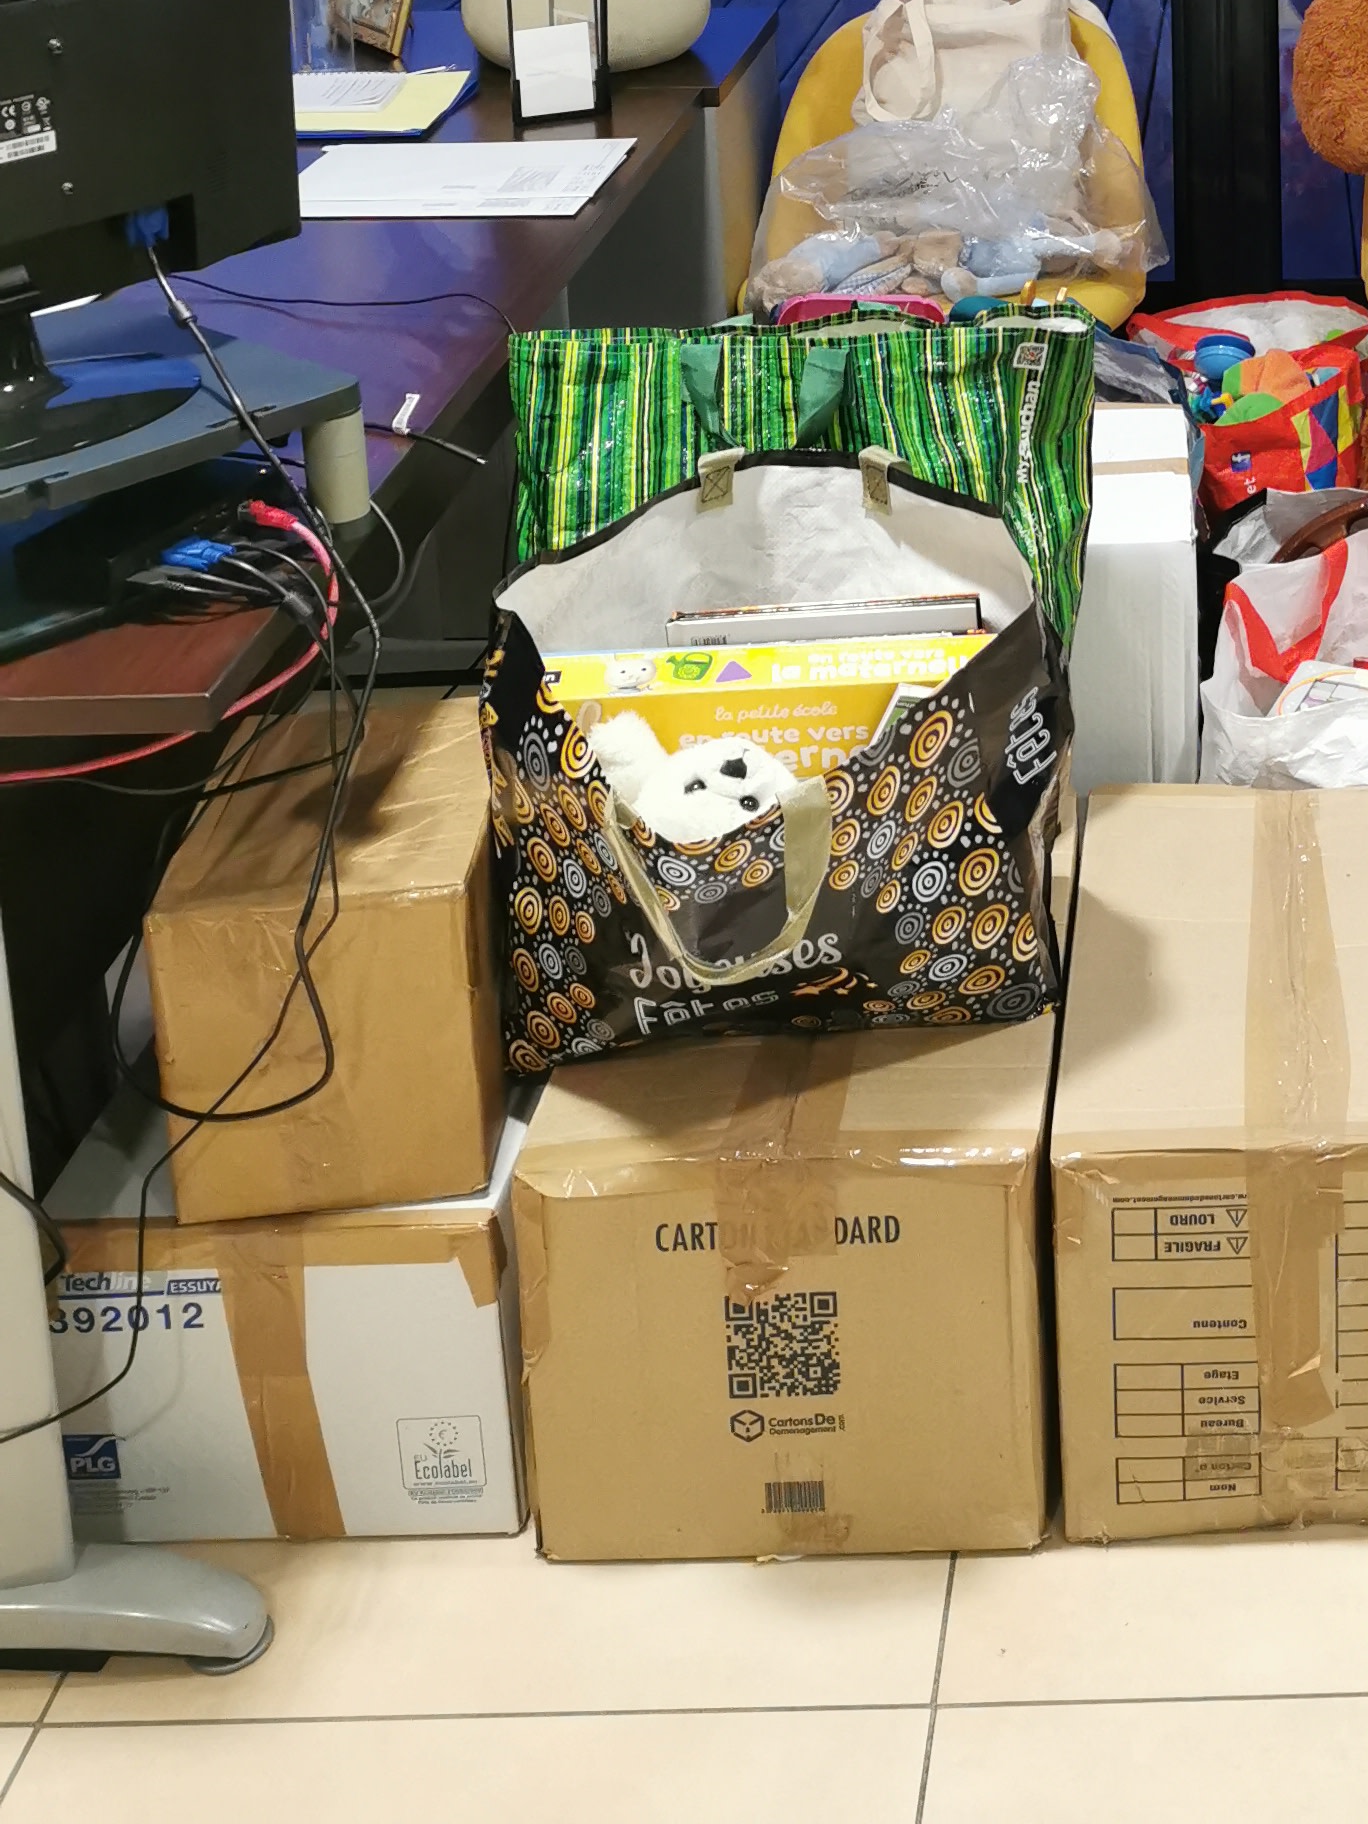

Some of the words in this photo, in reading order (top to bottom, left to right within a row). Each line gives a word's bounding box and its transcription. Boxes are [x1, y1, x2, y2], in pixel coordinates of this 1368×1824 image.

[809, 655, 968, 681] maternell
[715, 706, 733, 722] la
[737, 703, 790, 723] petite
[792, 700, 838, 718] école
[807, 725, 869, 742] vers
[629, 932, 843, 994] Joyses
[1170, 1214, 1214, 1225] LOURD
[655, 1221, 756, 1252] CART
[1165, 1241, 1220, 1252] FRAGILE
[1193, 1320, 1247, 1329] Contenu
[1204, 1370, 1239, 1380] Etage
[1199, 1396, 1245, 1405] Service
[1201, 1419, 1244, 1428] Bureau
[70, 1457, 116, 1473] PLG
[415, 1458, 472, 1480] Ecolabel
